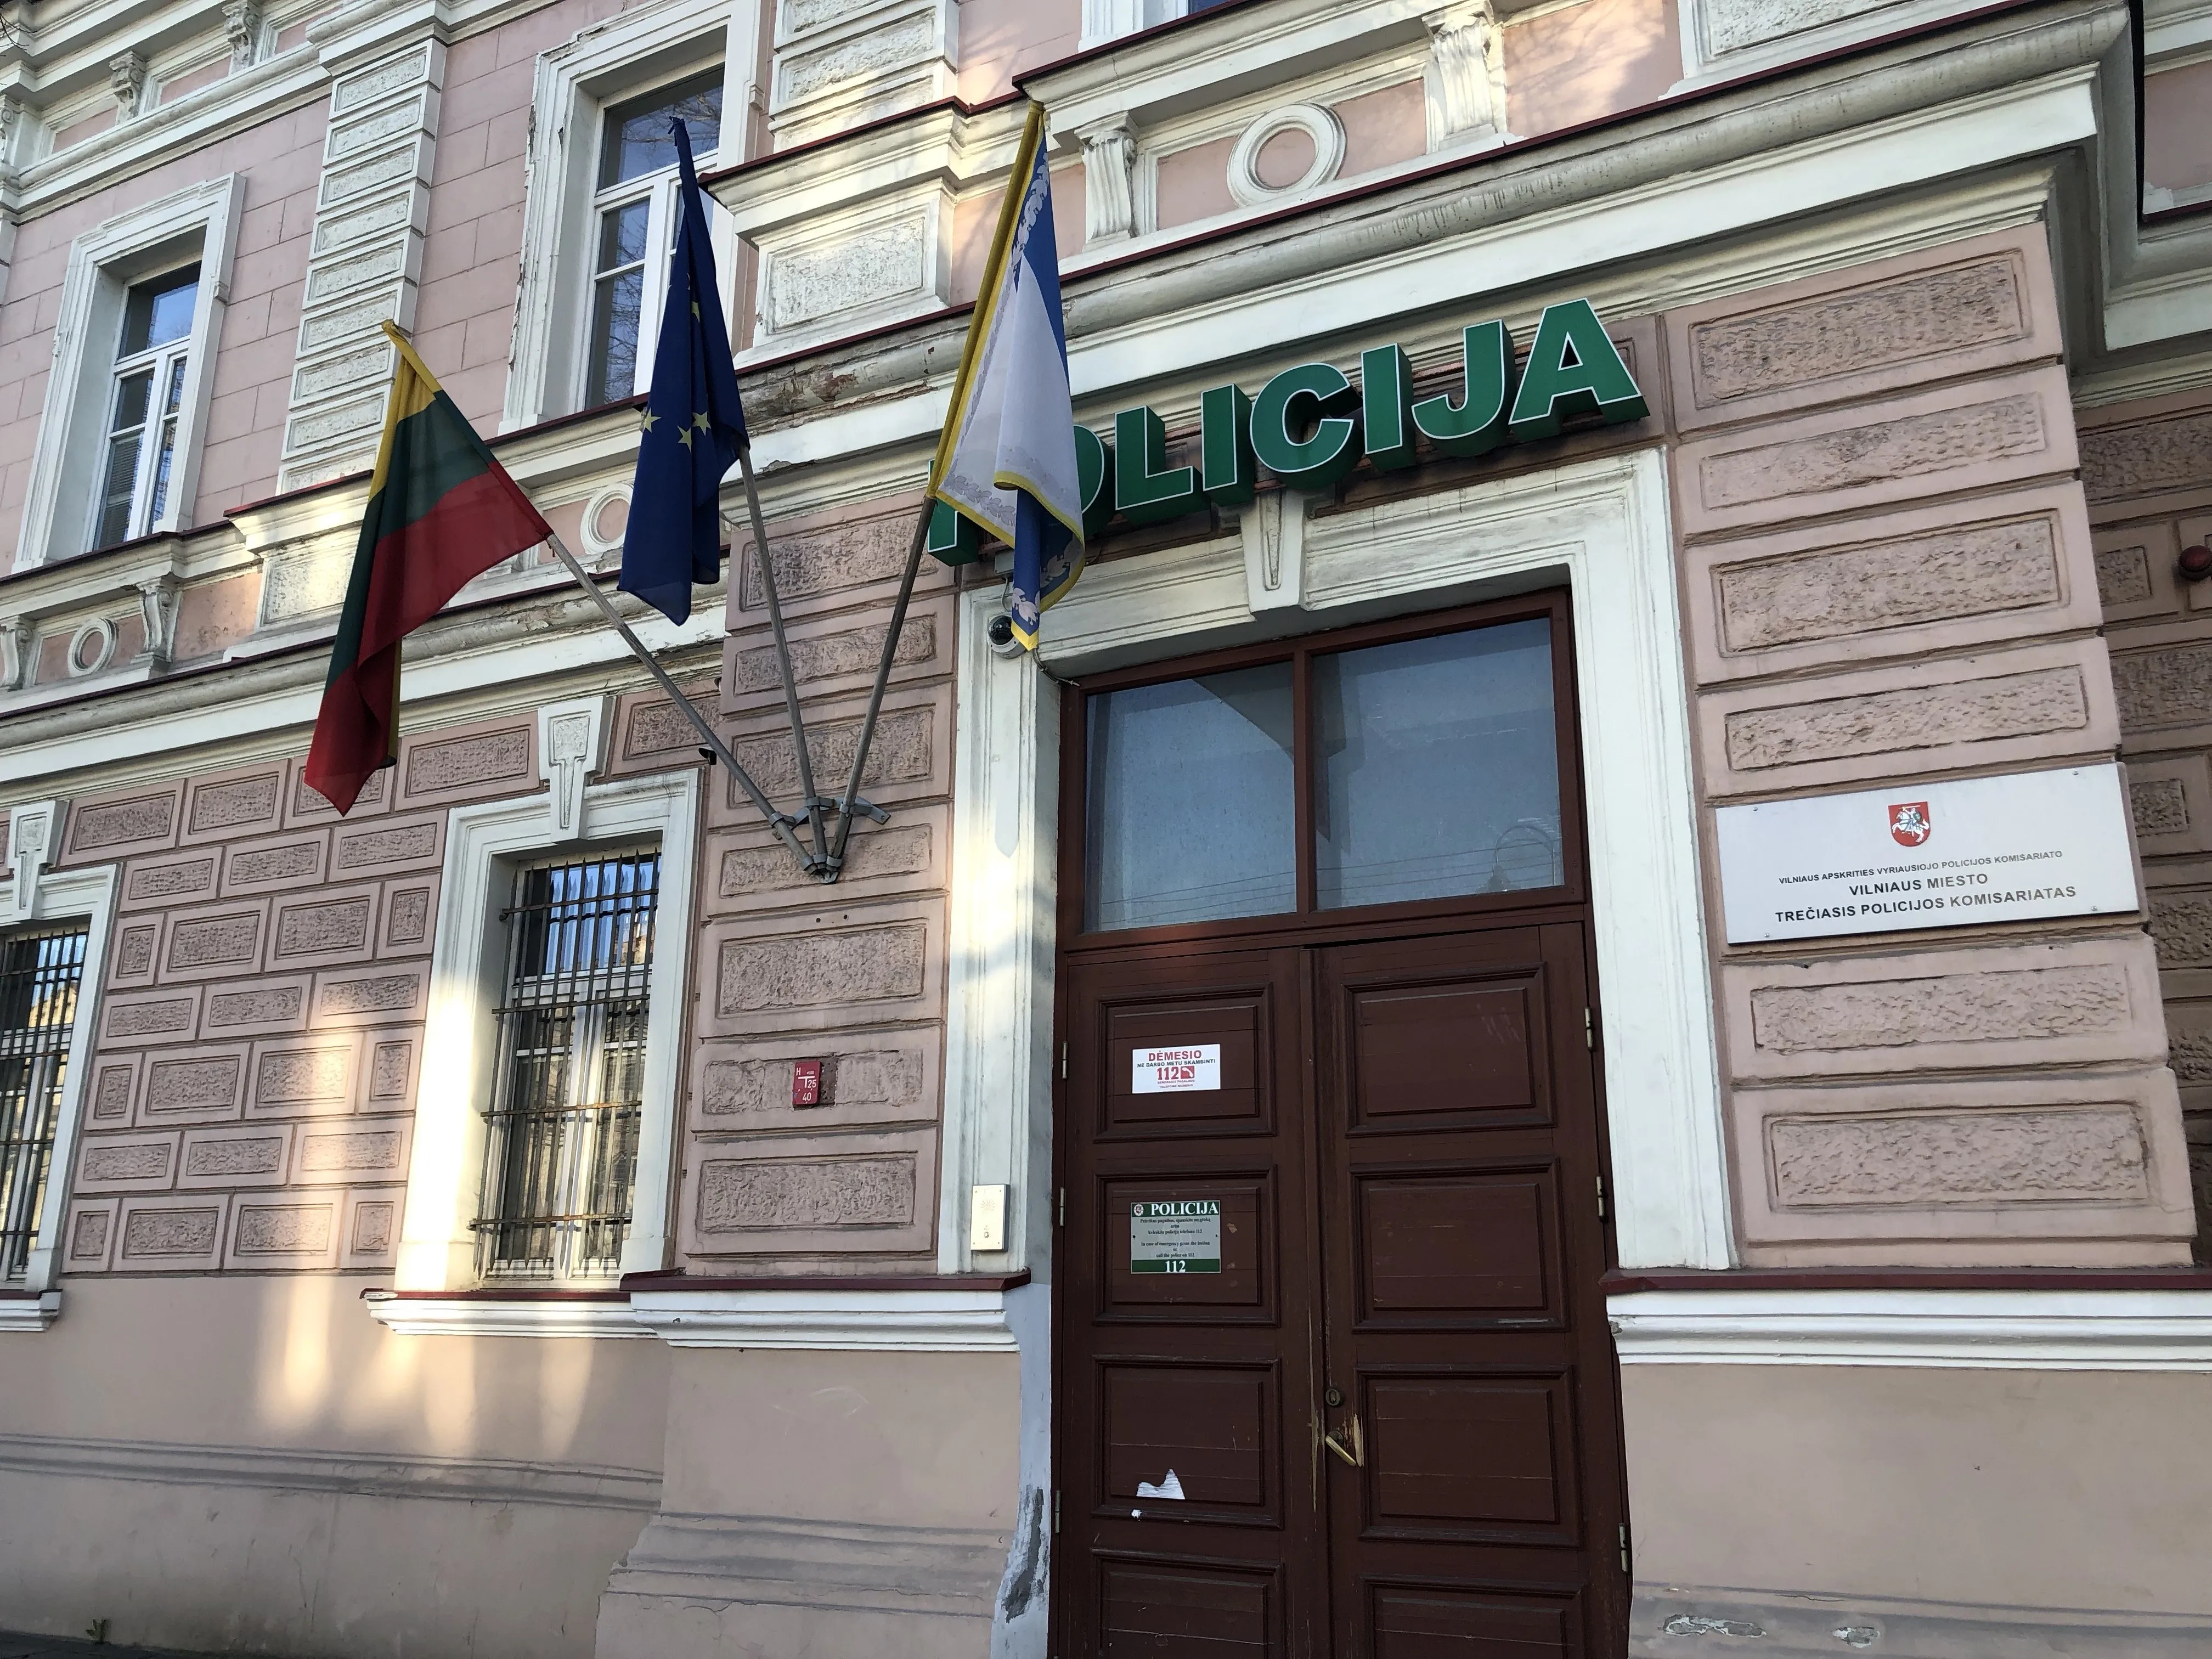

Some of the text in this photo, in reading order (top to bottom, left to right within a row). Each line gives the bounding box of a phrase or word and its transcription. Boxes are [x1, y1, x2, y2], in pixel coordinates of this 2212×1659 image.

[1779, 850, 2063, 884] VILNIAUS APSKRITIES VYRIAUSIOJO POLICIJOS KOMISARIATO
[1849, 873, 1988, 895] VILNIAUS MIESTO
[1775, 886, 2076, 922] TREČIASIS POLICIJOS KOMISARIATAS
[1148, 1050, 1202, 1062] DĖMESIO
[796, 1068, 802, 1076] H
[1157, 1066, 1179, 1080] 112
[1150, 1202, 1218, 1216] POLICIJA
[1165, 1260, 1186, 1273] 112
